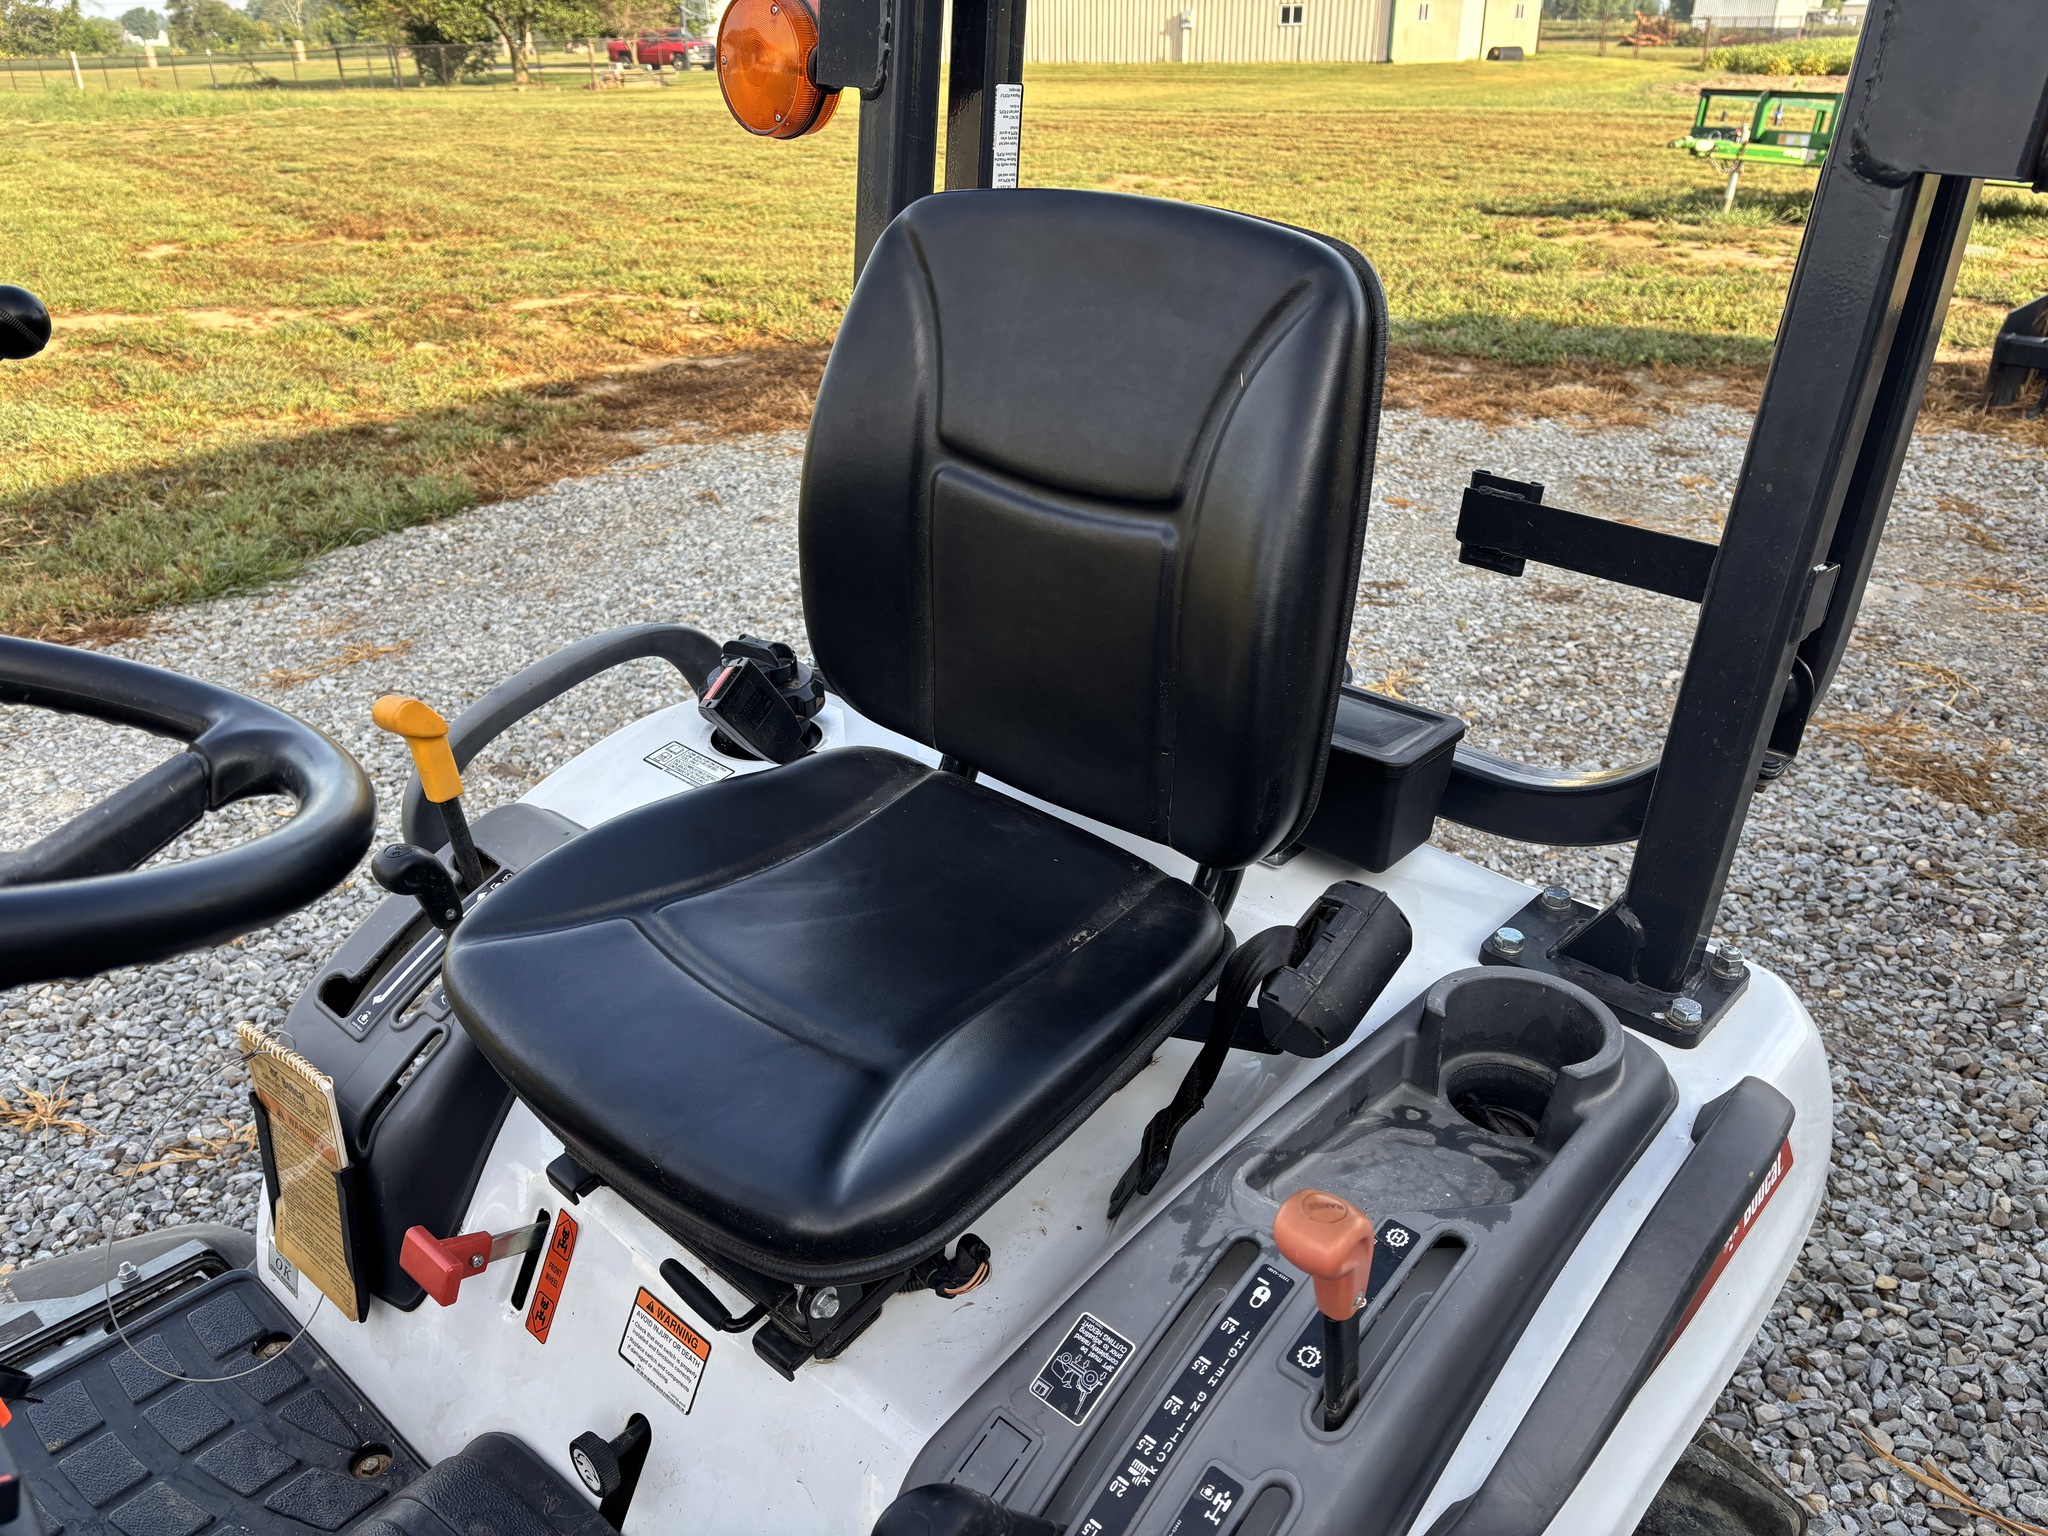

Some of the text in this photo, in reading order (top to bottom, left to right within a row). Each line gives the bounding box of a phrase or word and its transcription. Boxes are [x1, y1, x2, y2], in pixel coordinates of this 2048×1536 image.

[1393, 1232, 1402, 1242] H
[276, 1258, 291, 1282] OK
[545, 1272, 558, 1289] WHEEL
[548, 1261, 562, 1278] FRONT
[656, 1307, 699, 1350] WARNING
[1220, 1320, 1238, 1334] 4.0
[632, 1330, 649, 1345] installed
[648, 1342, 657, 1352] and
[656, 1348, 675, 1368] functions
[634, 1322, 698, 1379] Check that seat switch is properly
[636, 1310, 701, 1368] AVOID INJURY OR DEATH
[1073, 1333, 1118, 1366] completely raised
[1079, 1326, 1124, 1359] prior to adjusting
[1102, 1334, 1127, 1353] CUTTING
[629, 1337, 645, 1353] Replace
[645, 1350, 657, 1363] switch
[657, 1361, 665, 1371] and
[665, 1367, 690, 1393] components
[630, 1347, 648, 1367] damaged
[648, 1362, 653, 1370] or
[1080, 1346, 1114, 1372] 3PT must be
[1191, 1359, 1210, 1375] 3.5
[1163, 1399, 1182, 1416] 3.0
[1156, 1390, 1207, 1463] CUTTING
[1136, 1439, 1155, 1457] 2.5
[1109, 1479, 1127, 1498] 2.0
